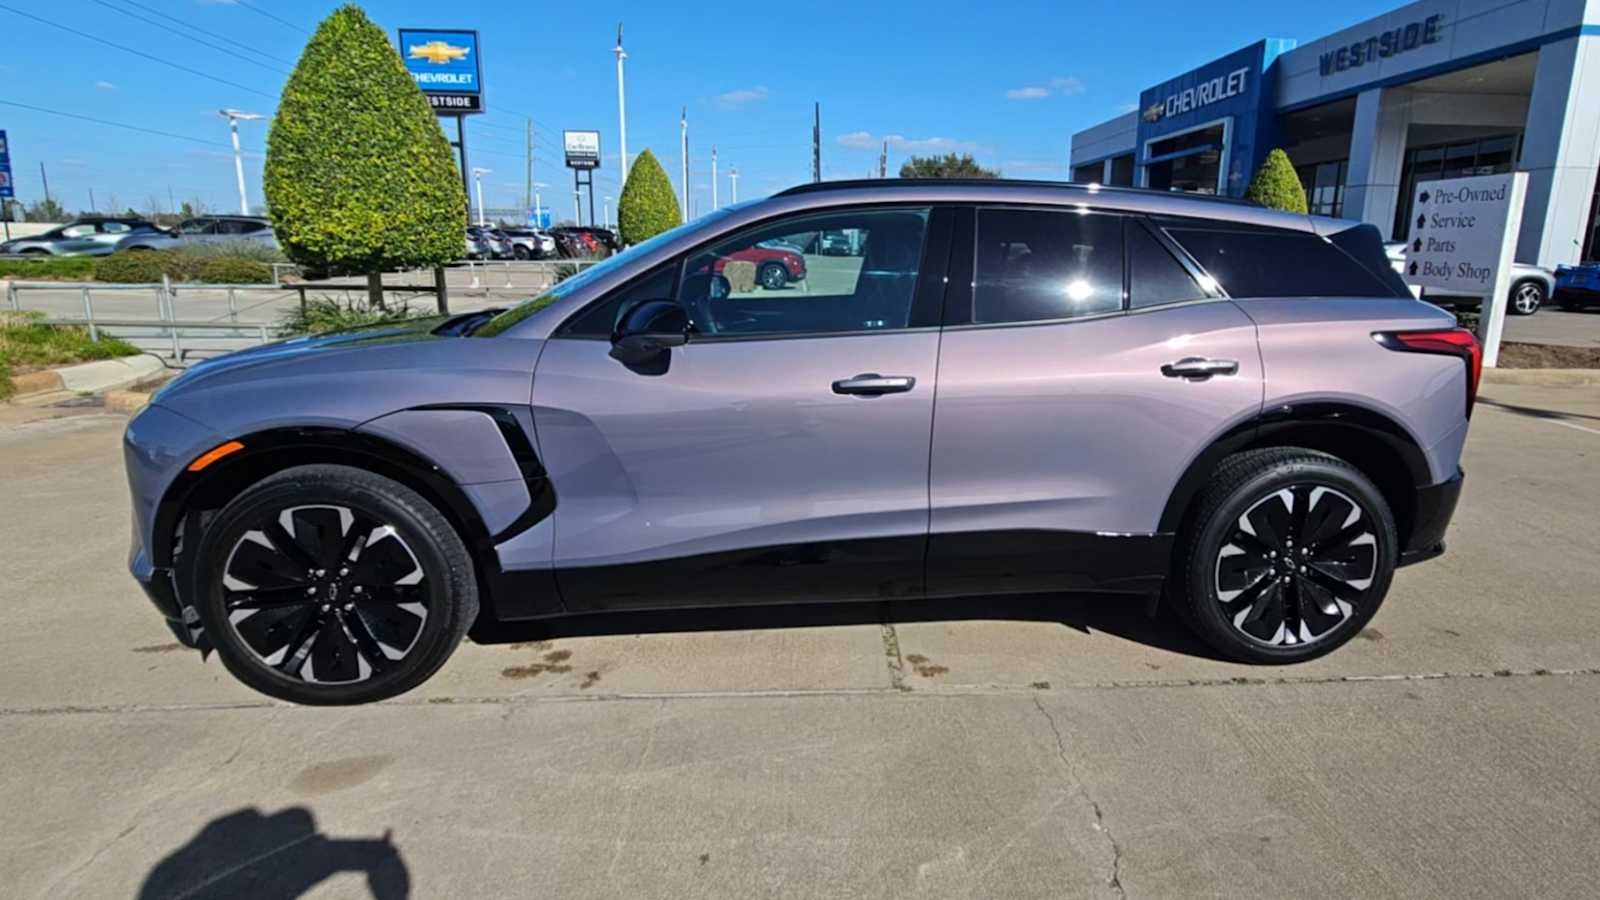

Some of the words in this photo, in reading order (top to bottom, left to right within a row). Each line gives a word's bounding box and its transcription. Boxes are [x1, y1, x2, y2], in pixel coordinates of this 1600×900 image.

[1319, 14, 1443, 76] WESTSIDE
[426, 95, 471, 107] ESTSIDE
[1165, 67, 1249, 117] CHEVROLET
[1434, 184, 1506, 204] Pre-Owned
[1430, 213, 1476, 229] Service
[1426, 238, 1456, 252] Parts
[1422, 262, 1452, 280] Body
[1456, 263, 1490, 283] Shop
